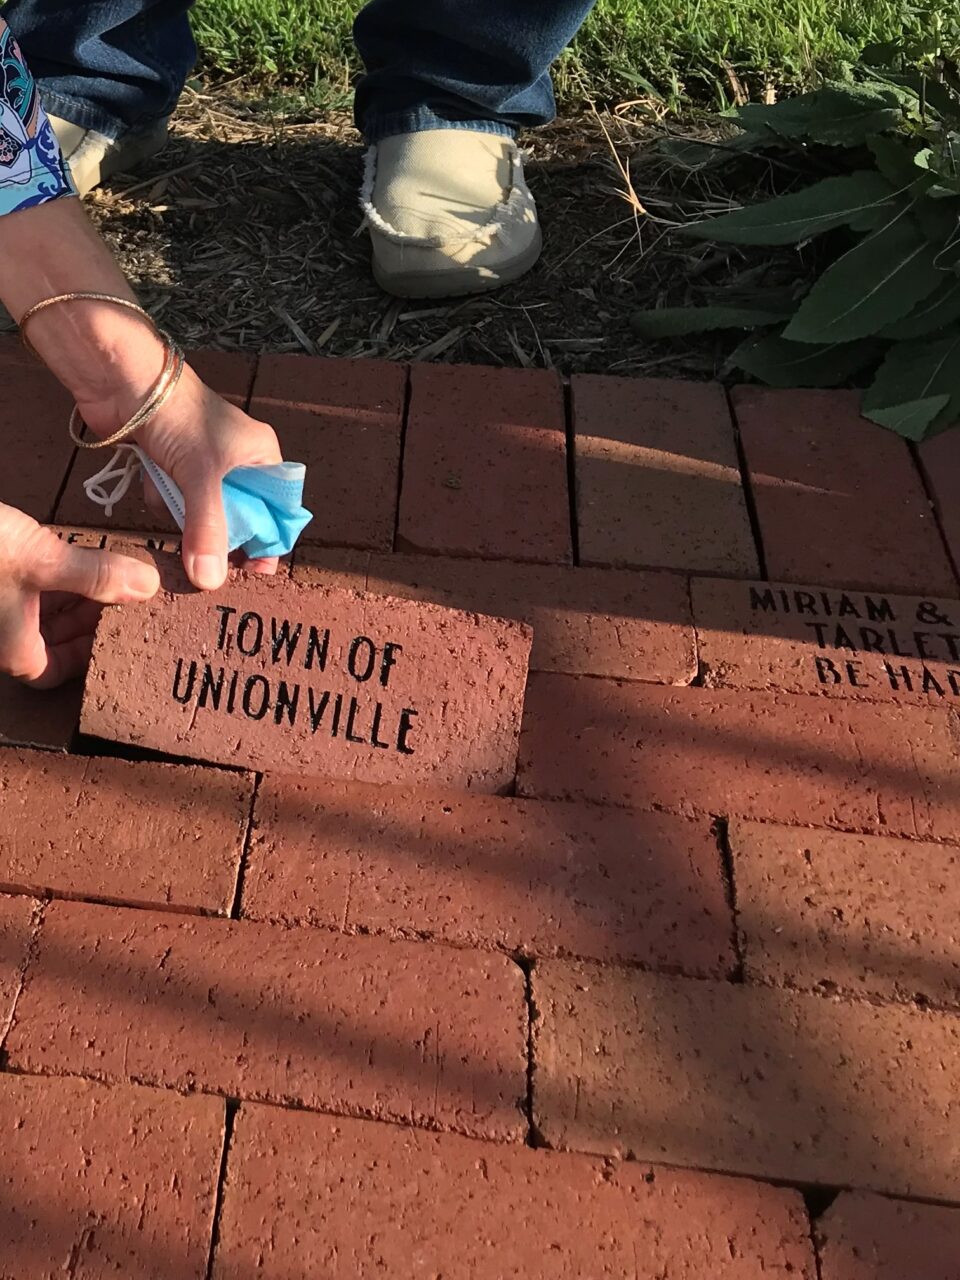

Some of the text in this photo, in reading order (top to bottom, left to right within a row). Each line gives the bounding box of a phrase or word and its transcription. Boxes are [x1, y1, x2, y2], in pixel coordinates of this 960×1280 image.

[749, 587, 954, 626] MIRIAM &
[216, 605, 403, 687] TOWN OF
[815, 656, 869, 688] BE
[172, 658, 419, 755] UNIONVILLE
